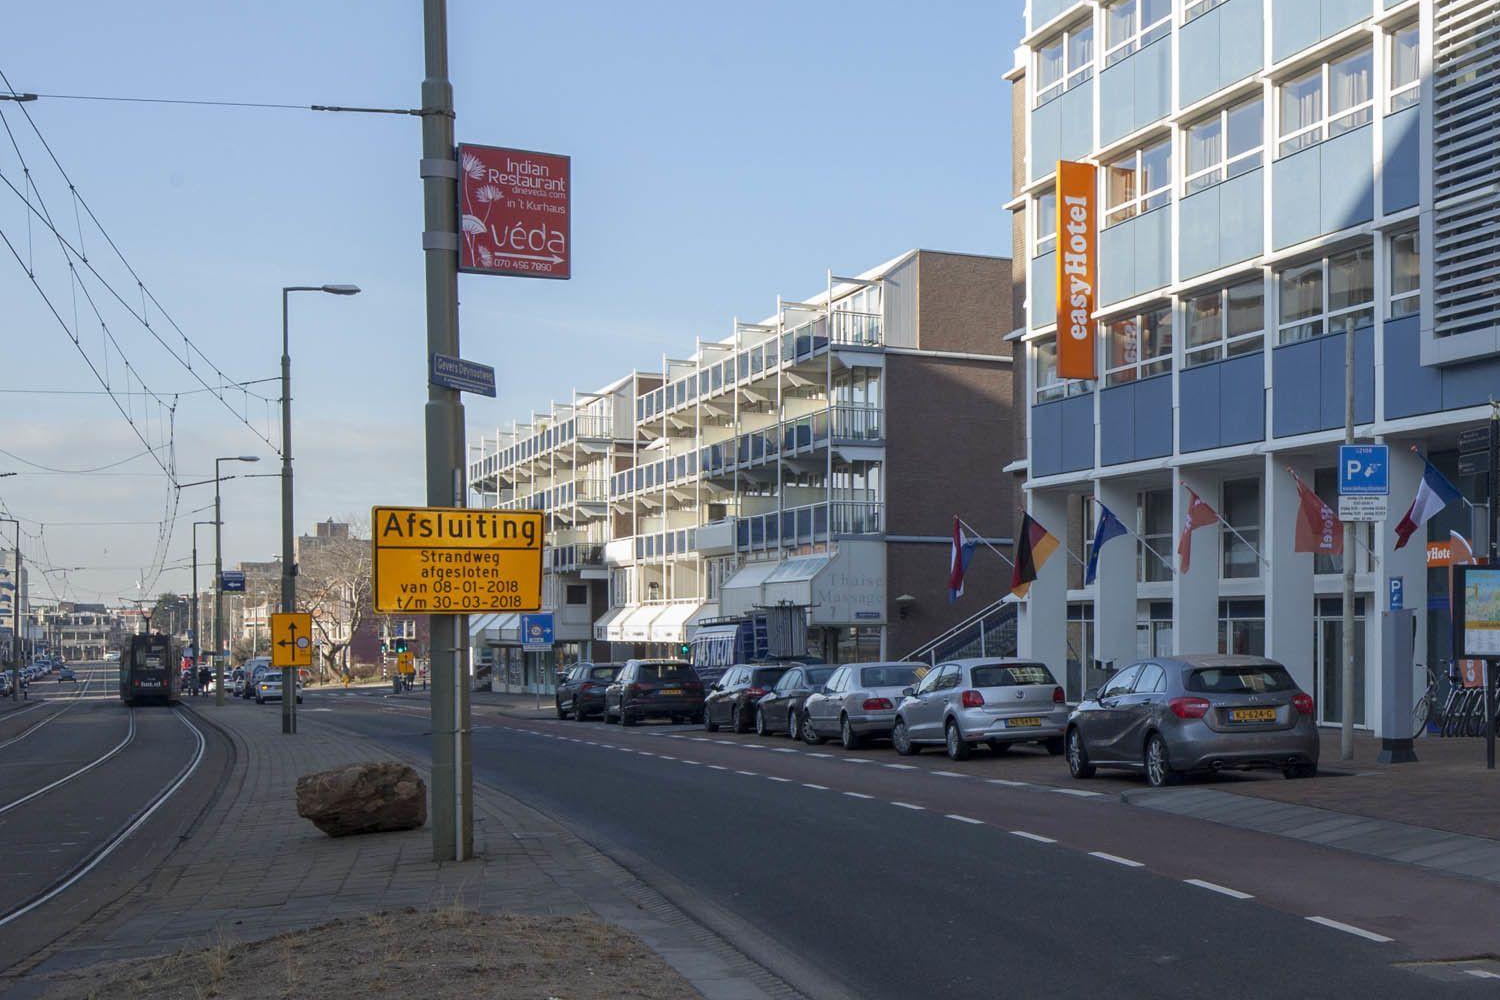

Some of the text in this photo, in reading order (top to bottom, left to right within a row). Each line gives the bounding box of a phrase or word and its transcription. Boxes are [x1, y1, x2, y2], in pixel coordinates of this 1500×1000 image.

[507, 157, 549, 177] Indian
[488, 168, 566, 192] Restaurant
[507, 200, 516, 209] in
[526, 201, 566, 214] Kurhaus
[491, 220, 565, 254] véda
[494, 258, 511, 268] 070
[1064, 196, 1092, 341] easyHotel
[1347, 459, 1361, 481] P
[383, 511, 536, 547] Afsluiting
[420, 550, 500, 567] Strandweg
[420, 566, 500, 582] afgesloten
[400, 581, 519, 594] van 08-01-2018
[397, 596, 522, 609] t/m 30-03-2018
